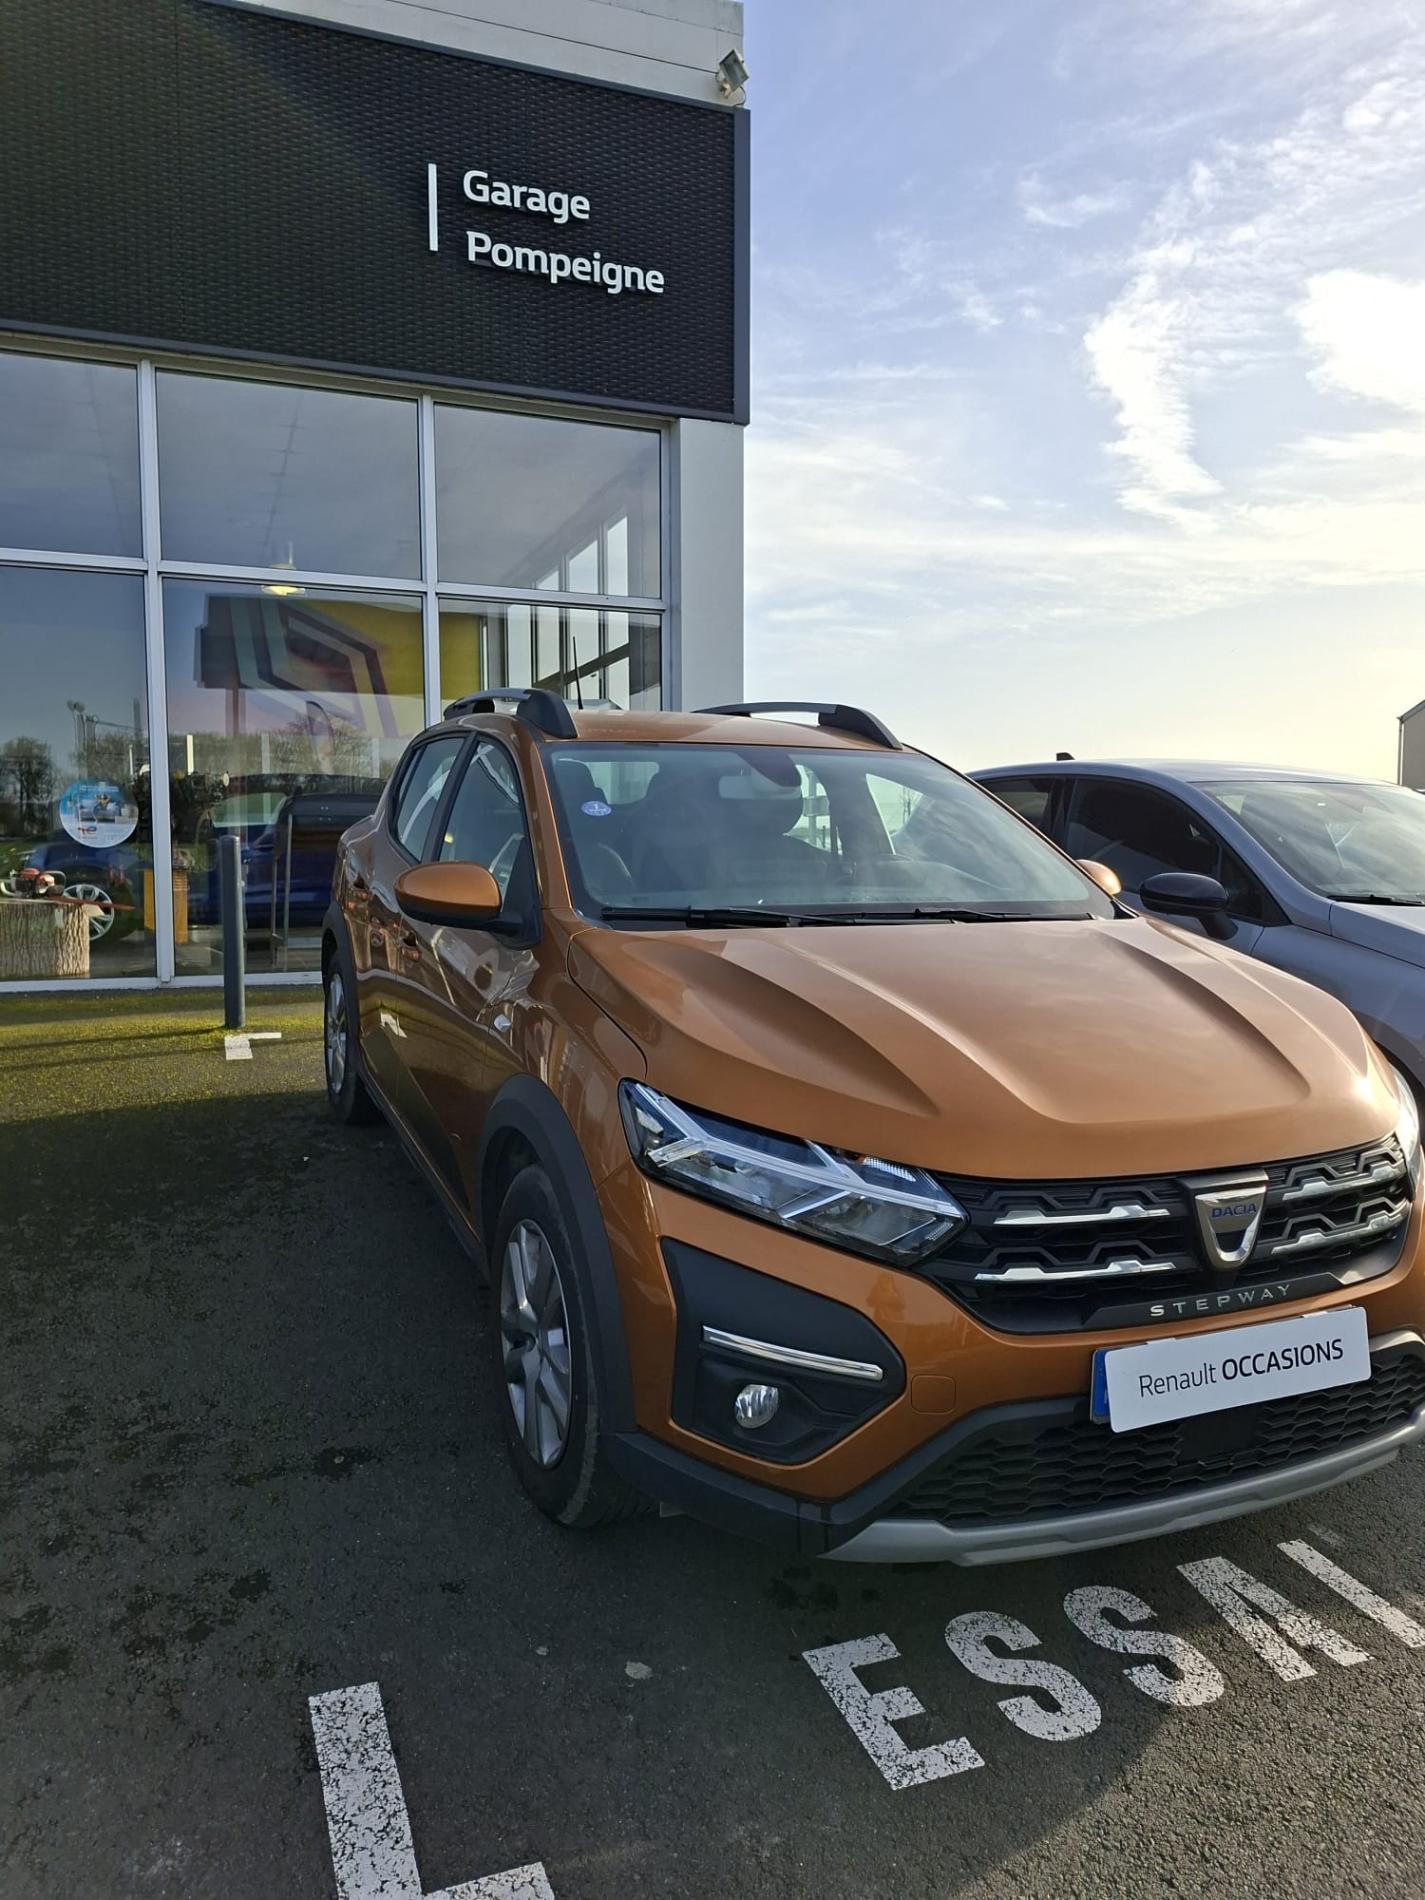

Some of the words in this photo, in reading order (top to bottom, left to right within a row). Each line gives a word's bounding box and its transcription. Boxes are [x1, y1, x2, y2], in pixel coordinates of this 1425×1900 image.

[463, 170, 590, 224] Garage
[466, 230, 664, 294] Pompeigne
[1211, 1202, 1257, 1219] DACIA
[1149, 1283, 1291, 1318] STEPWAY
[1138, 1362, 1217, 1398] Renault
[1221, 1338, 1344, 1381] OCCASIONS
[801, 1538, 1425, 1791] ESSAI
